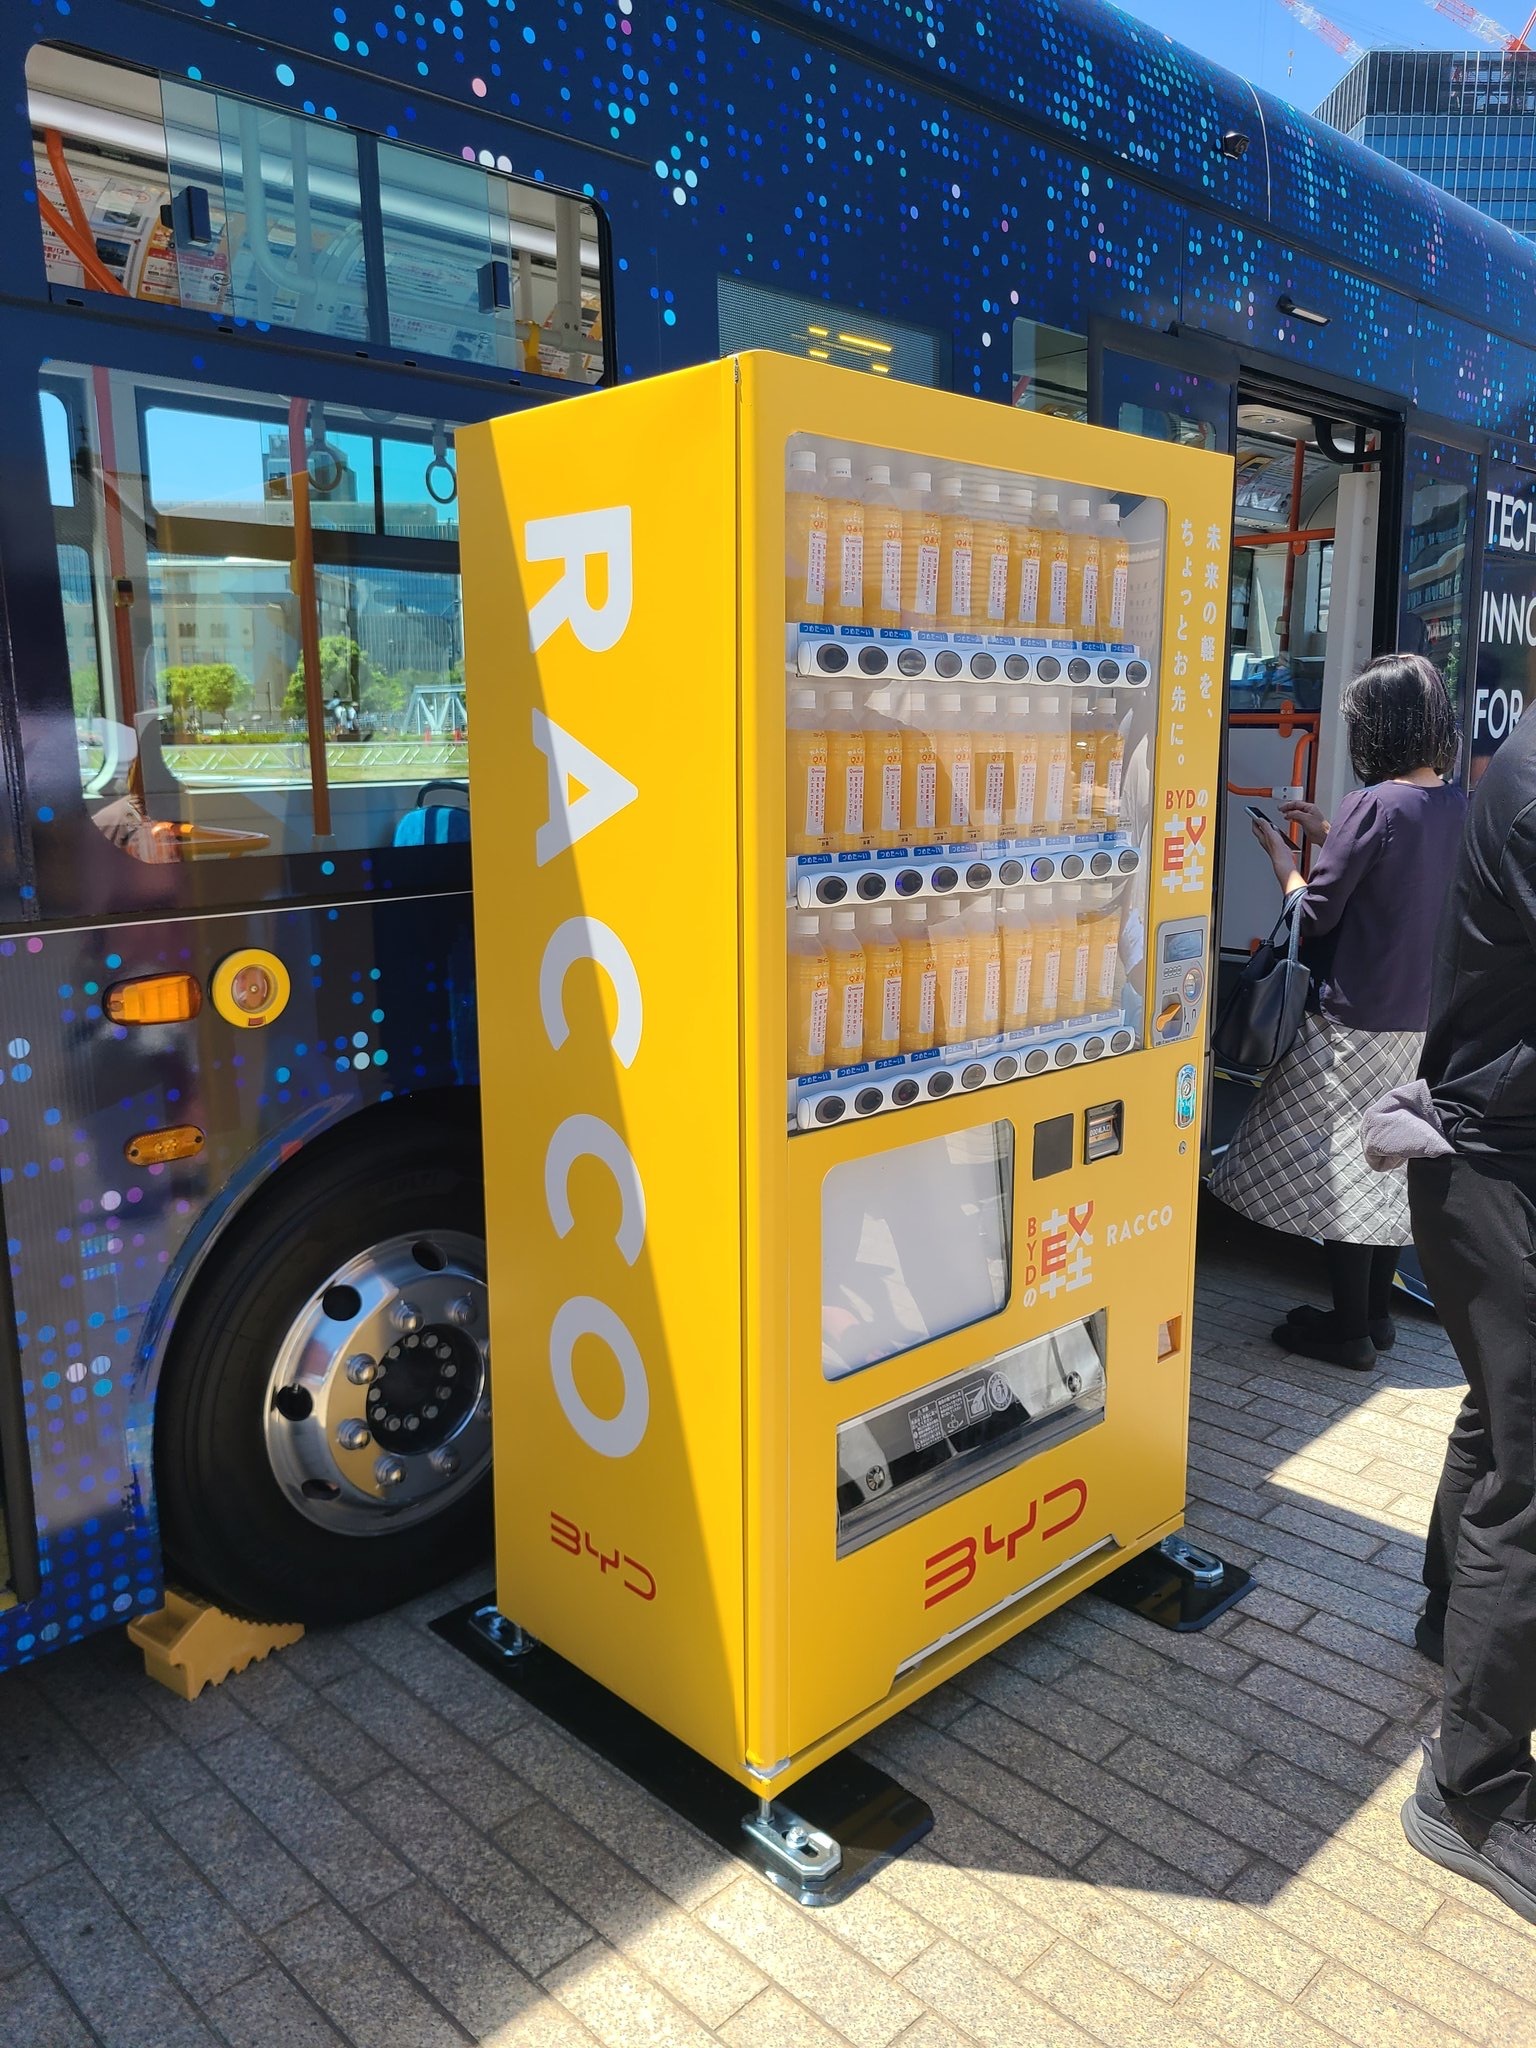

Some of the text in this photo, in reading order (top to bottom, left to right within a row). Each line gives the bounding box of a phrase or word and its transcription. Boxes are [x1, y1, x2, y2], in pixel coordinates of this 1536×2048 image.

[1170, 518, 1194, 765] ちょっとお先に。
[1200, 523, 1221, 718] 未来の軽を、
[1473, 688, 1523, 739] FOR
[1165, 789, 1208, 809] BYDの
[525, 505, 649, 1458] RACCO
[1023, 1217, 1037, 1307] BYDの
[1106, 1204, 1173, 1247] RACCO
[550, 1510, 657, 1601] BYD
[924, 1478, 1088, 1610] BYD
